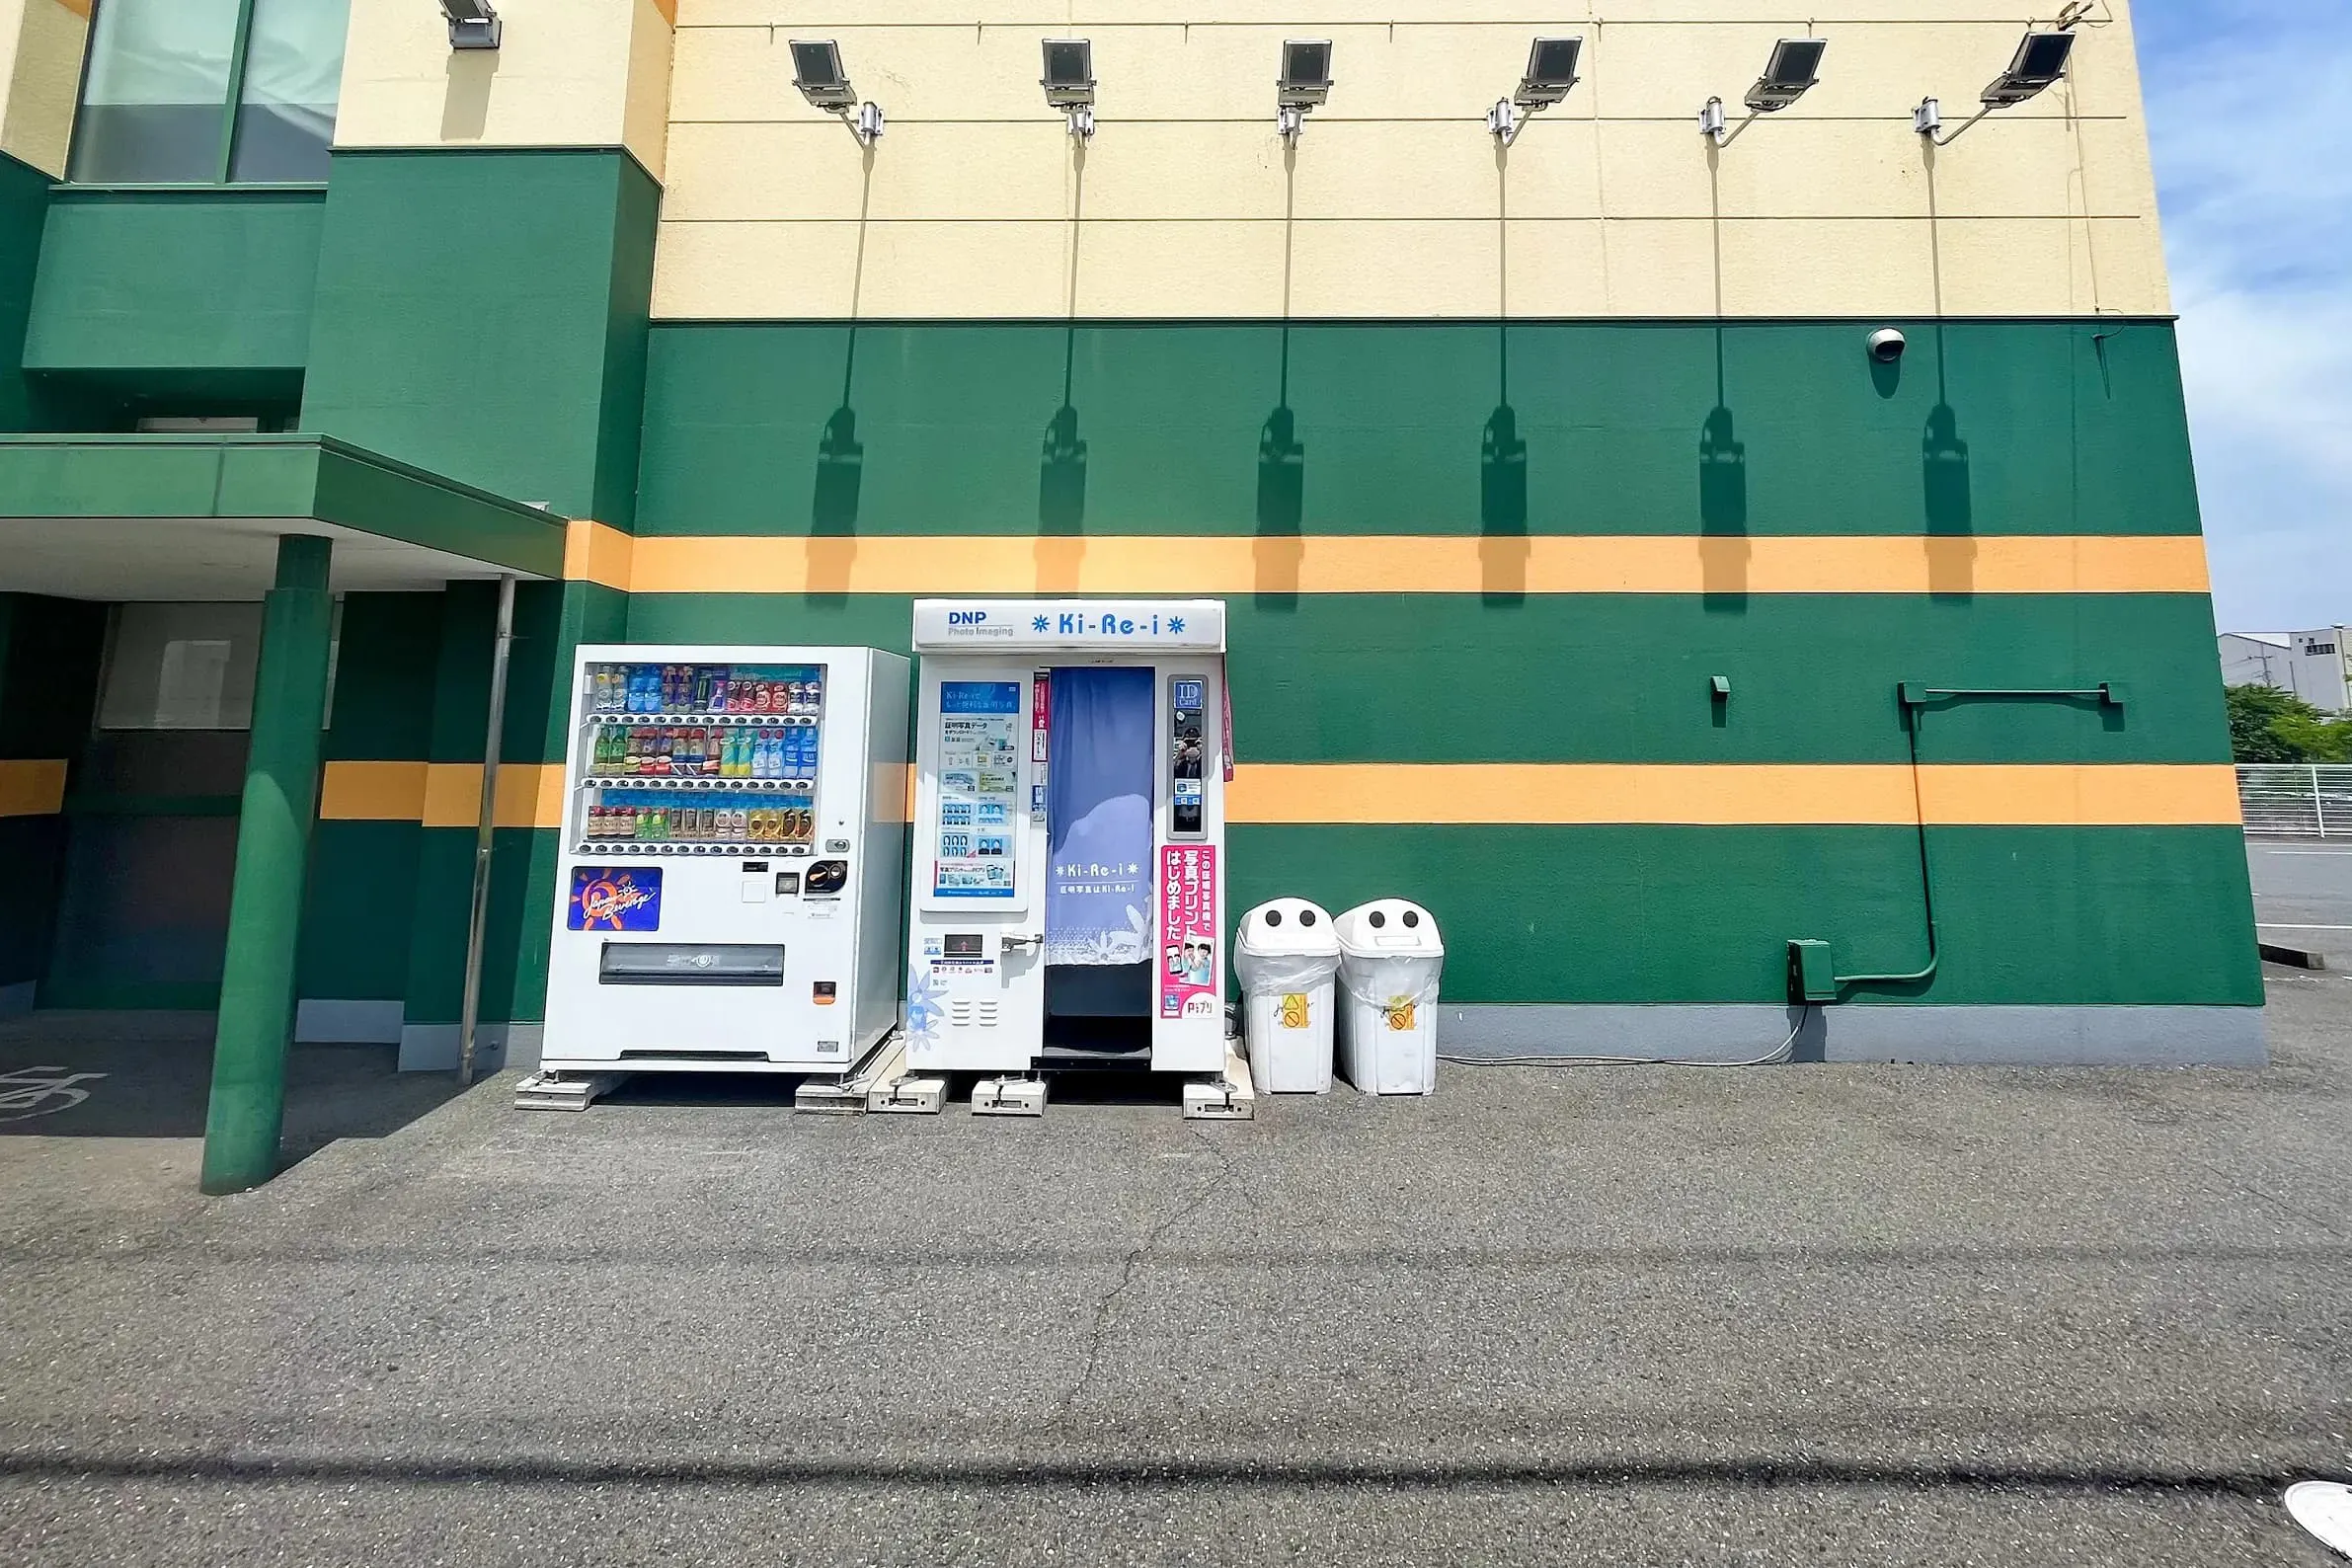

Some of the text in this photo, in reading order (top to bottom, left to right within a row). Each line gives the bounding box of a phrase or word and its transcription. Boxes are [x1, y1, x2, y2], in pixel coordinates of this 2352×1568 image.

[948, 611, 986, 624] DNP
[976, 627, 1013, 637] Imaging
[1179, 684, 1199, 699] ID
[583, 892, 626, 919] Japan
[600, 892, 657, 921] Beverage
[1166, 850, 1182, 941] はじめました
[1184, 850, 1200, 941] 写真プリント
